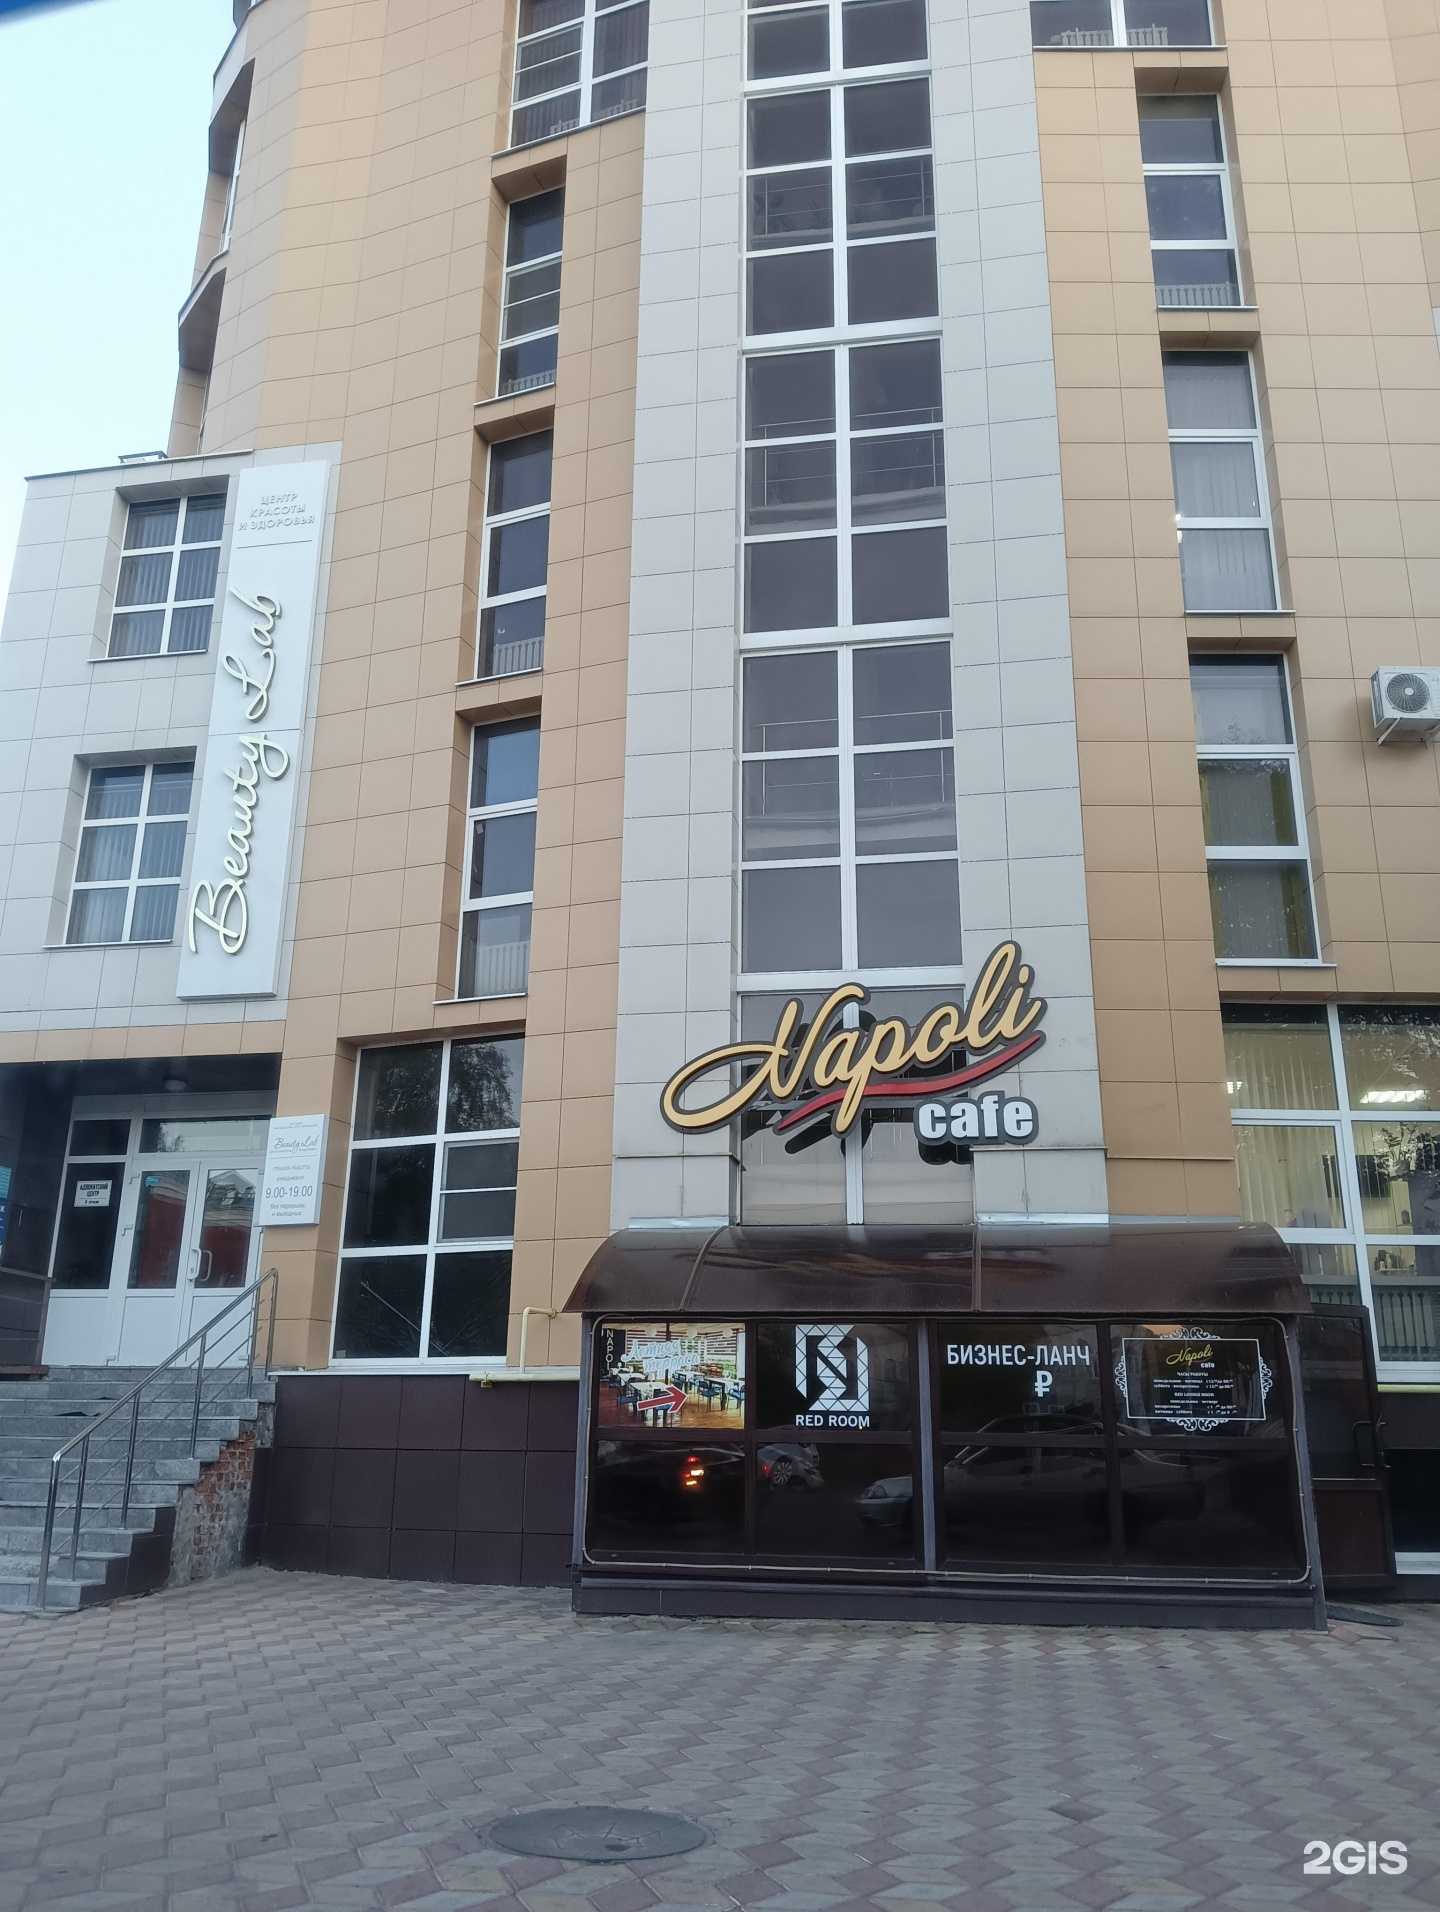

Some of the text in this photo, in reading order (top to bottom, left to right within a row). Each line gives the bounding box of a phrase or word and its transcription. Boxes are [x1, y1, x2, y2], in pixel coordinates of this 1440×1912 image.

[261, 492, 298, 505] ЦЕНТР
[249, 504, 306, 518] КРАСОТЫ
[239, 515, 315, 531] И ЗДОРОВЬЯ
[188, 585, 290, 954] Beauty Lab
[661, 940, 1046, 1136] Napoli
[917, 1093, 1036, 1141] cafe
[264, 1185, 313, 1199] 9.00-19.00
[946, 1344, 1091, 1366] БИЗНЕС-ЛАНЧ
[1165, 1343, 1214, 1366] Napoli
[795, 1414, 870, 1428] RED ROOM
